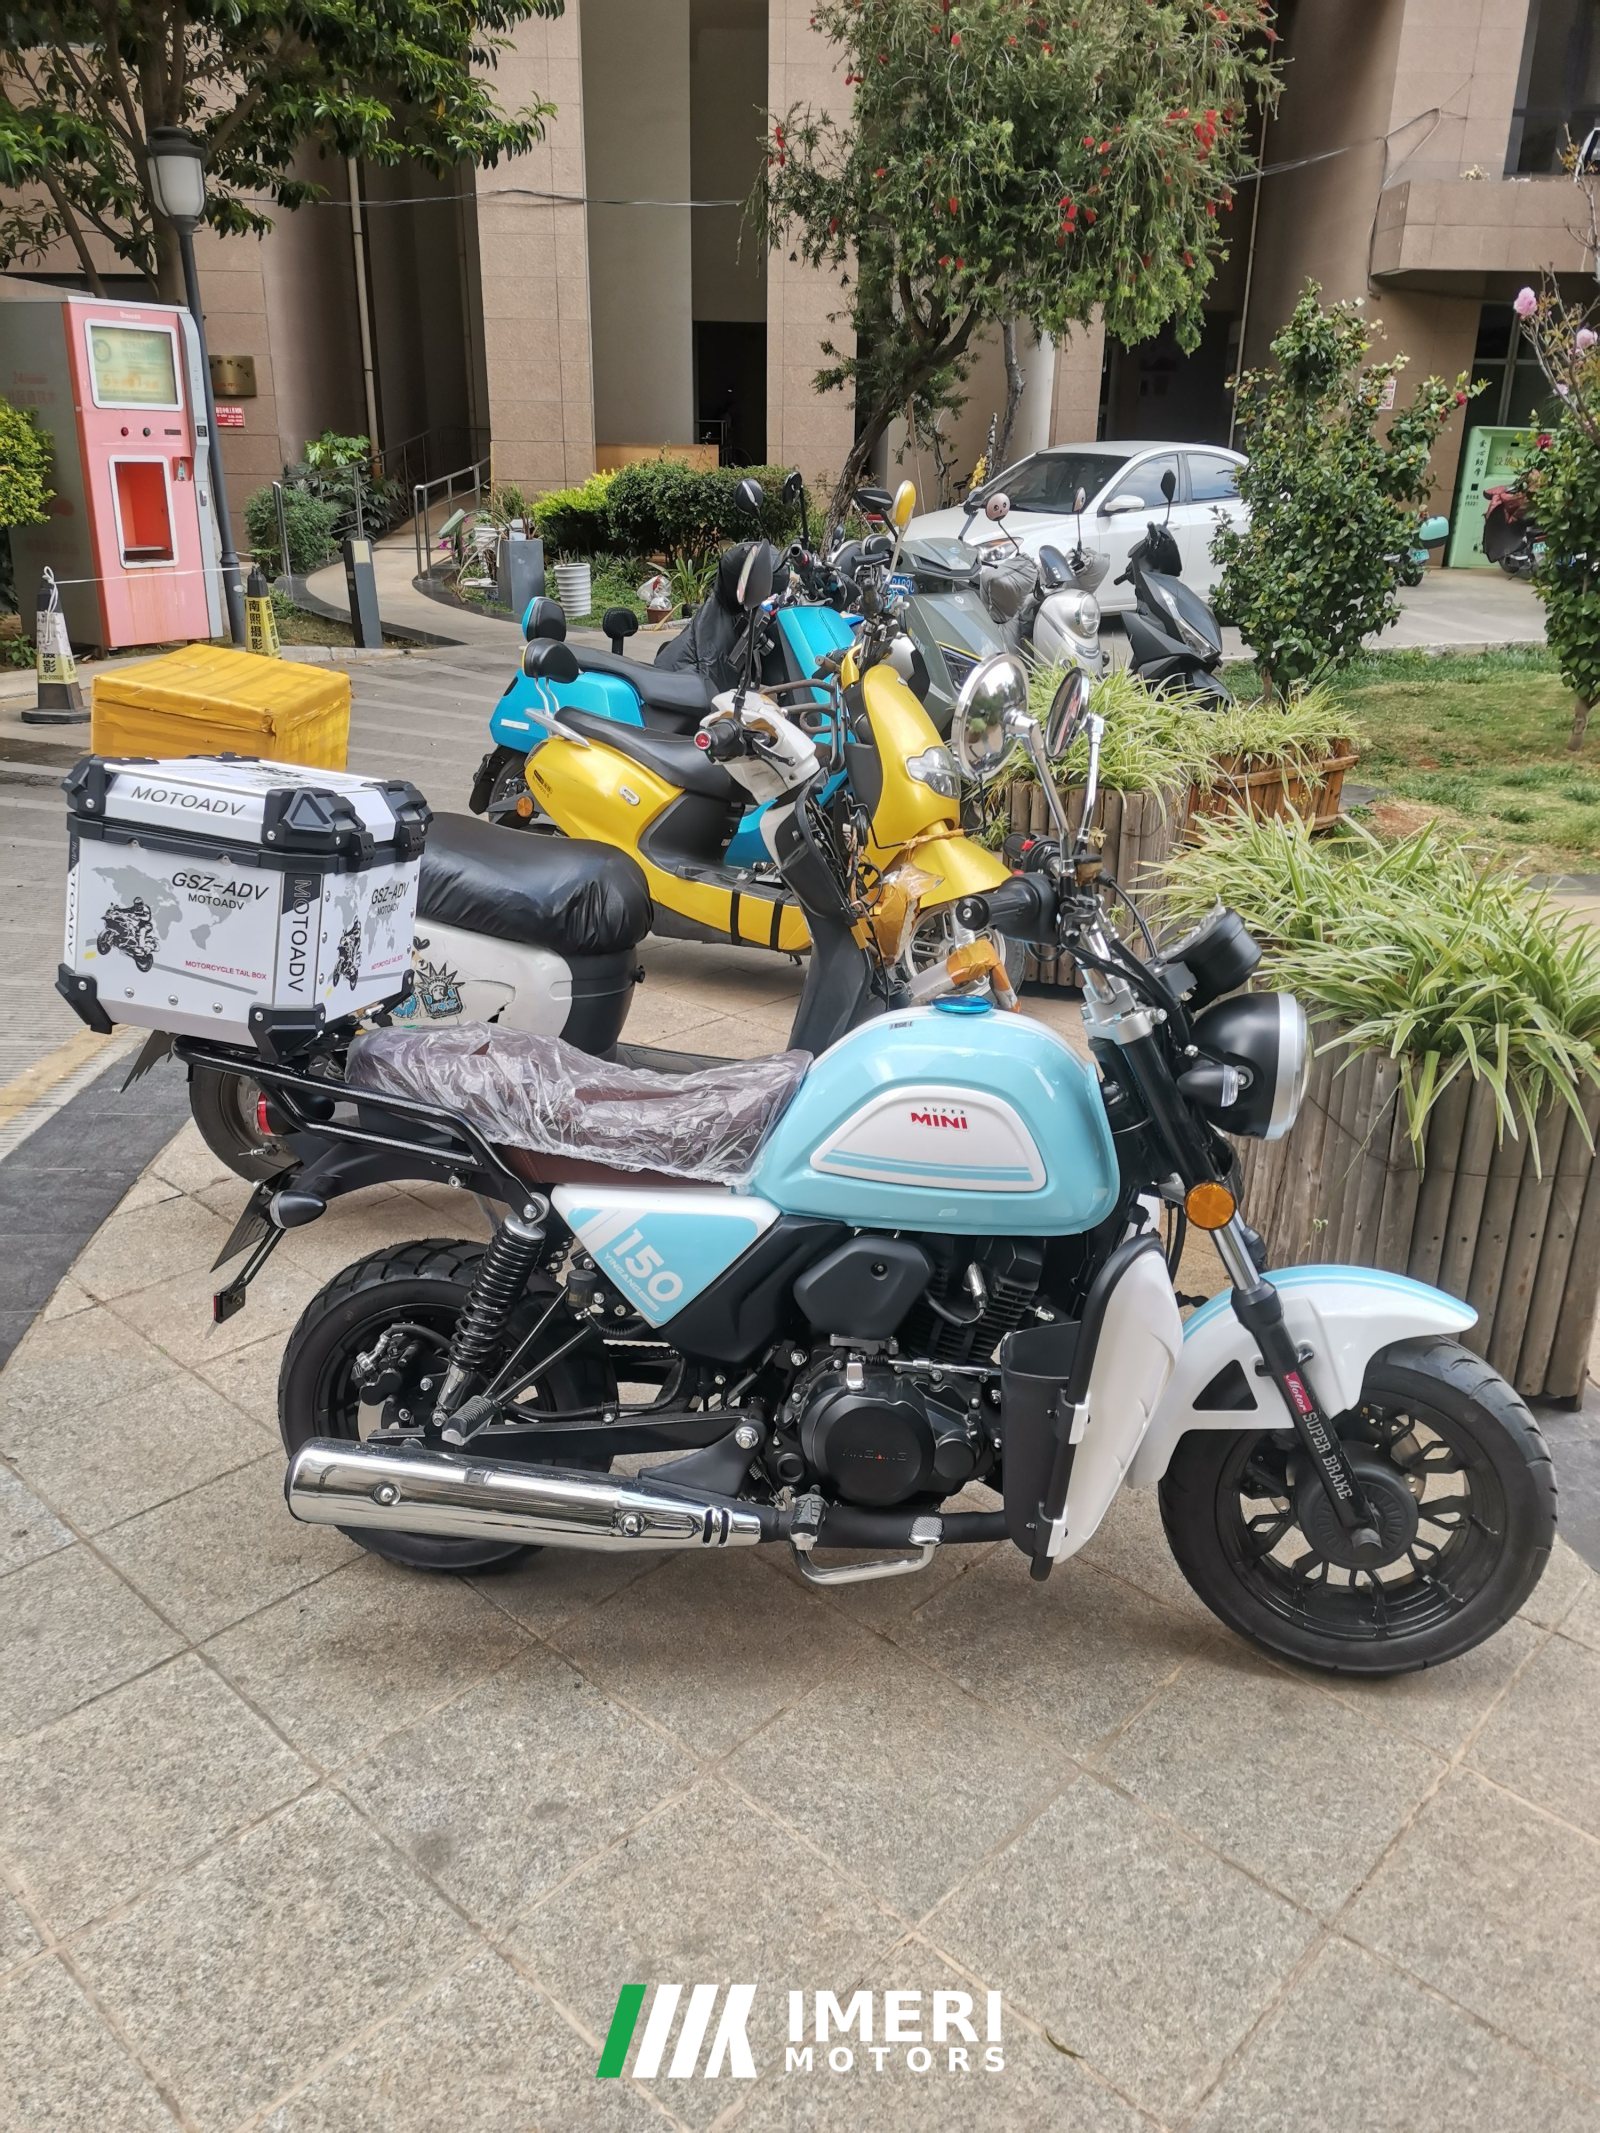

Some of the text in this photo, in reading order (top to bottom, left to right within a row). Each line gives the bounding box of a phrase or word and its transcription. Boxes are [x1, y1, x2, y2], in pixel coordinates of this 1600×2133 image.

[131, 786, 246, 816] MOTOADV
[172, 872, 270, 900] GSZ-ADV
[188, 892, 245, 910] MOTOADV
[371, 881, 410, 905] GSZ-ADV
[288, 879, 312, 992] MOTOADV
[185, 960, 267, 980] MOTORCYCLE TAIL BOX
[911, 1112, 968, 1129] MINI
[604, 1252, 642, 1292] YINGANG
[613, 1228, 683, 1302] 150
[1285, 1374, 1306, 1412] Motor
[1303, 1412, 1353, 1500] SUPER BRAKE
